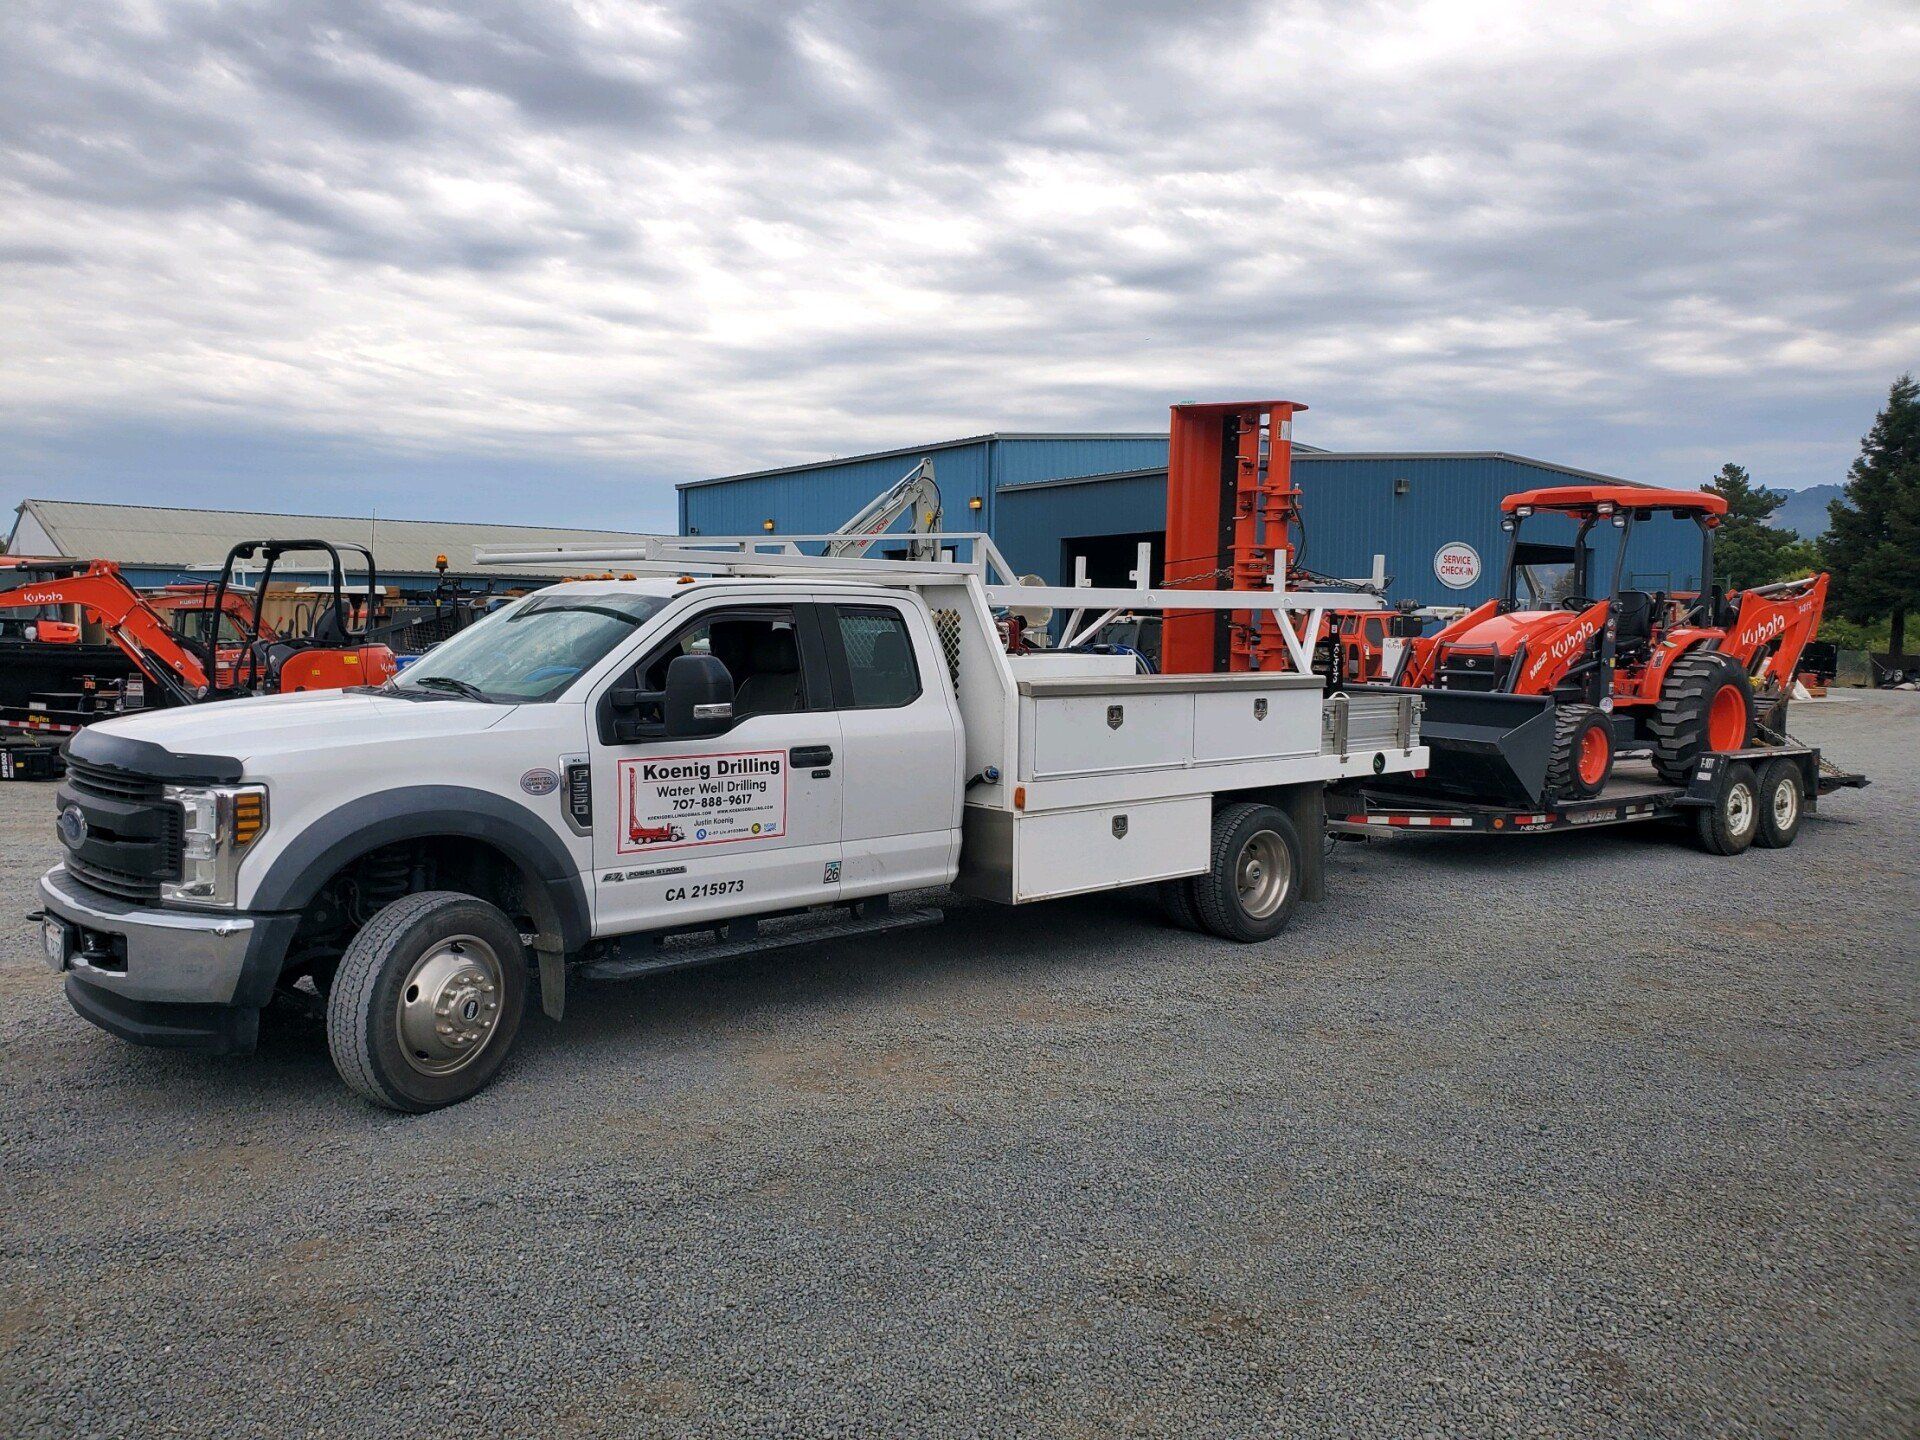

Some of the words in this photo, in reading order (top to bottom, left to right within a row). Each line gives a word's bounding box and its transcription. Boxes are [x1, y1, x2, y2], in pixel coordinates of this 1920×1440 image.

[1443, 554, 1471, 565] SERVICE
[1440, 565, 1474, 576] CHECK-IN
[23, 591, 63, 603] Kubota
[1742, 613, 1785, 646] Kubota
[1551, 620, 1594, 658] Kubota
[1332, 643, 1341, 684] Kubota
[1529, 651, 1548, 680] M62
[643, 761, 711, 781] Koenig
[717, 758, 780, 774] Drilling
[656, 785, 696, 798] Water
[698, 783, 724, 795] Well
[727, 780, 767, 793] Drilling
[672, 793, 753, 811] 707-888-9617
[693, 819, 712, 827] Justin
[713, 817, 734, 826] Koenig
[628, 869, 655, 878] POWER
[656, 865, 685, 875] STROKE
[825, 868, 839, 882] 26
[665, 887, 686, 901] CA
[690, 879, 744, 898] 215973
